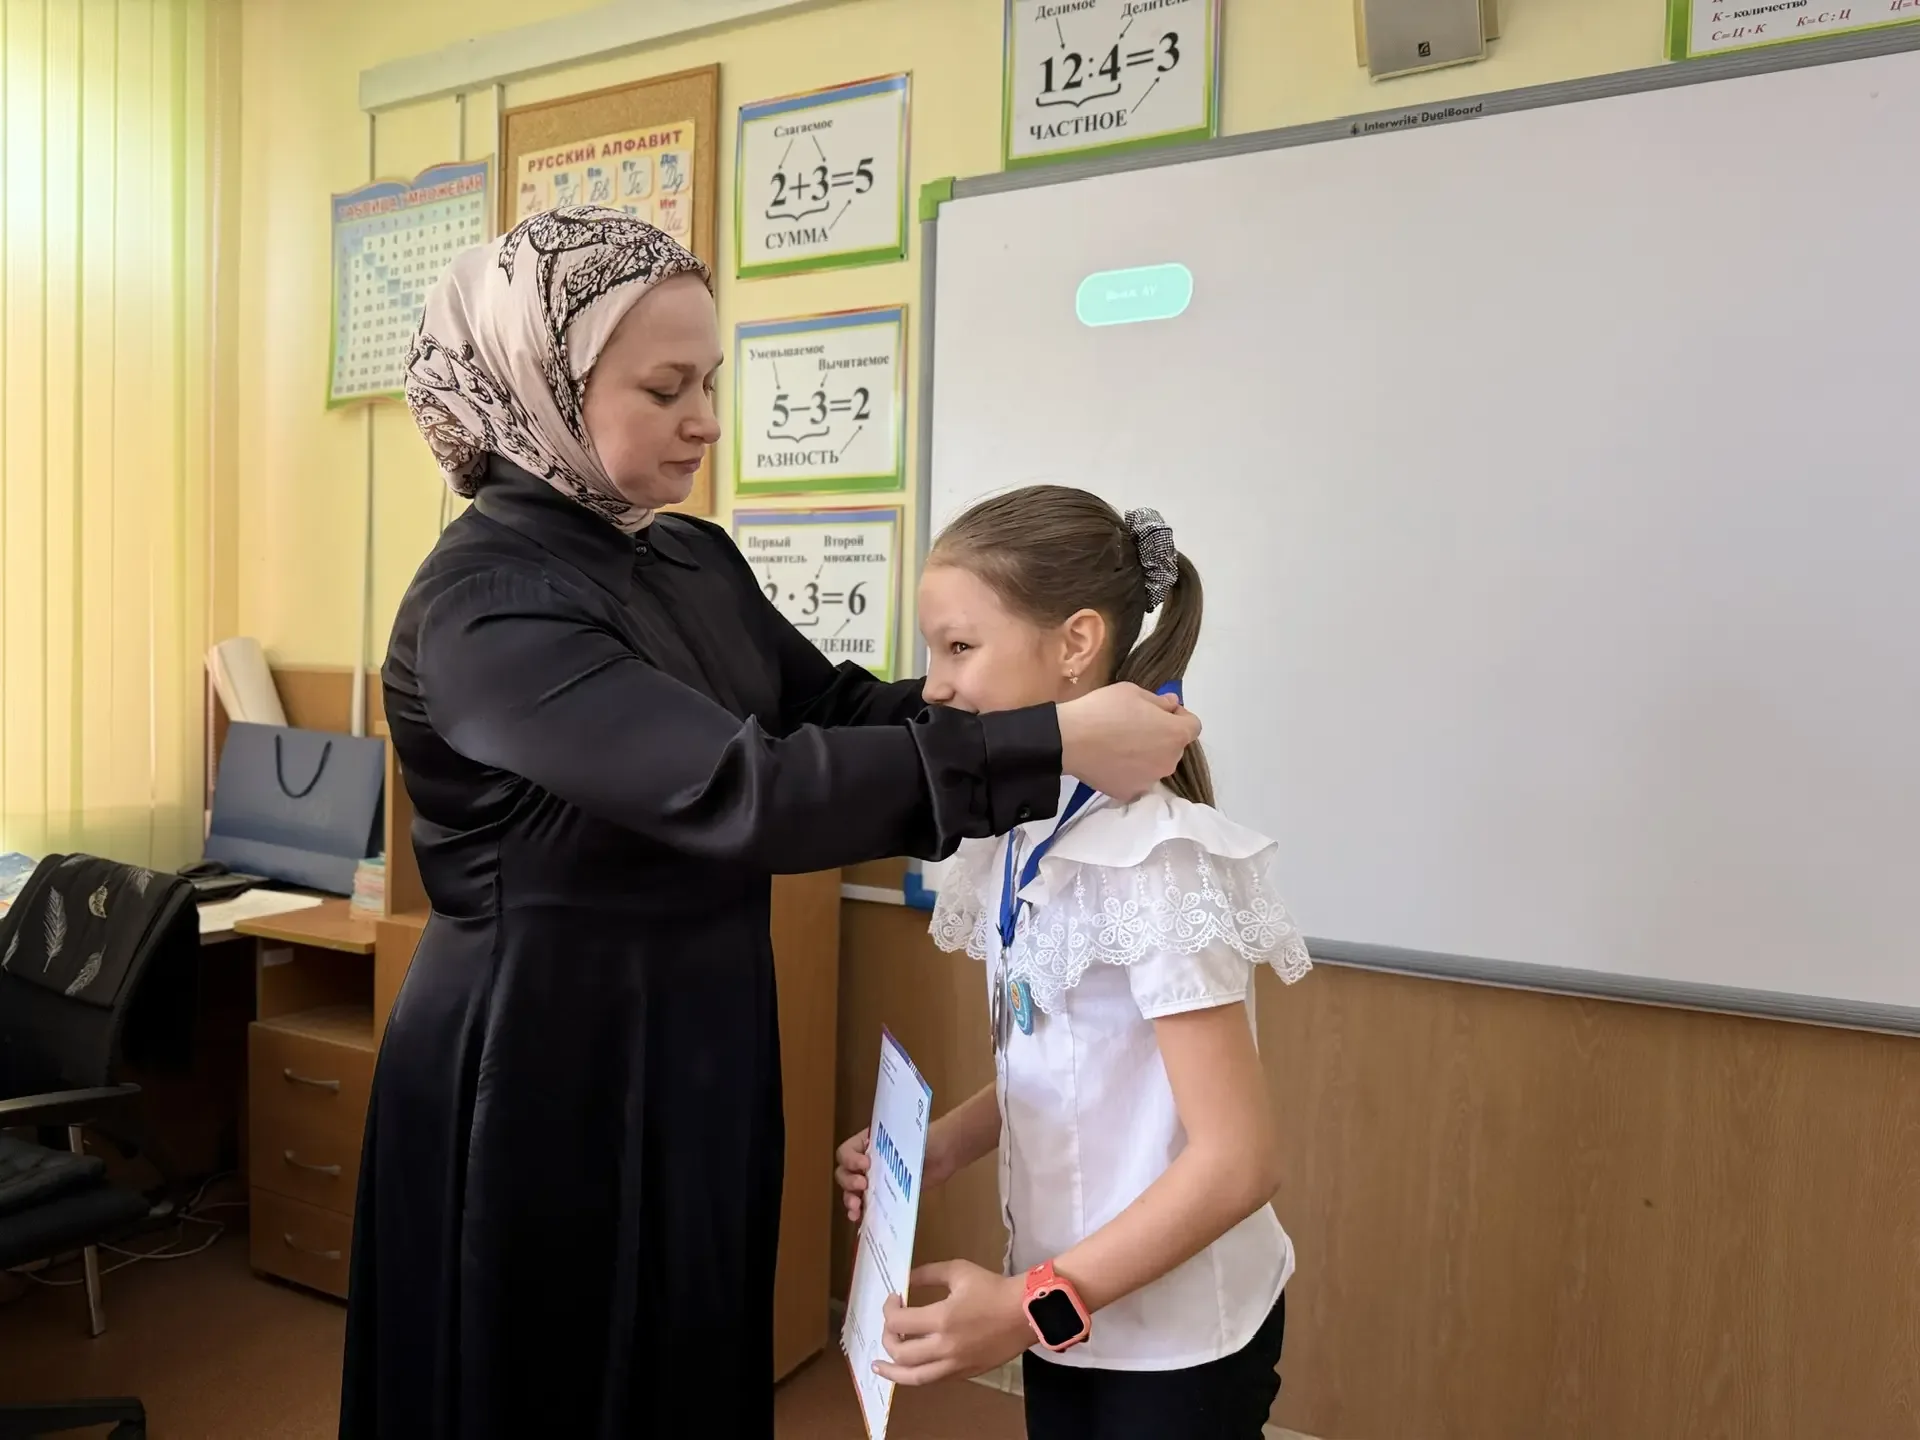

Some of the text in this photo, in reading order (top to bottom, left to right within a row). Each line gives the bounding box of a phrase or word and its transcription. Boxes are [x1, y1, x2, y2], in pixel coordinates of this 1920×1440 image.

[1120, 0, 1190, 20] Делите
[1734, 0, 1808, 18] количество
[1030, 109, 1127, 140] ЧАСТНОЕ
[1364, 103, 1483, 132] Interwrite DualBoard
[774, 119, 833, 138] Слагаемое
[528, 130, 683, 173] РУССКИЙ АЛФАВИТ
[765, 227, 829, 249] СУММА
[749, 344, 825, 360] Уменьшаемое
[818, 354, 890, 371] Вычитаемое
[757, 450, 839, 468] РАЗНОСТЬ
[748, 535, 864, 550] Первый Второй
[748, 553, 886, 564] множитель множитель
[875, 1120, 913, 1204] ДИПЛОМ
